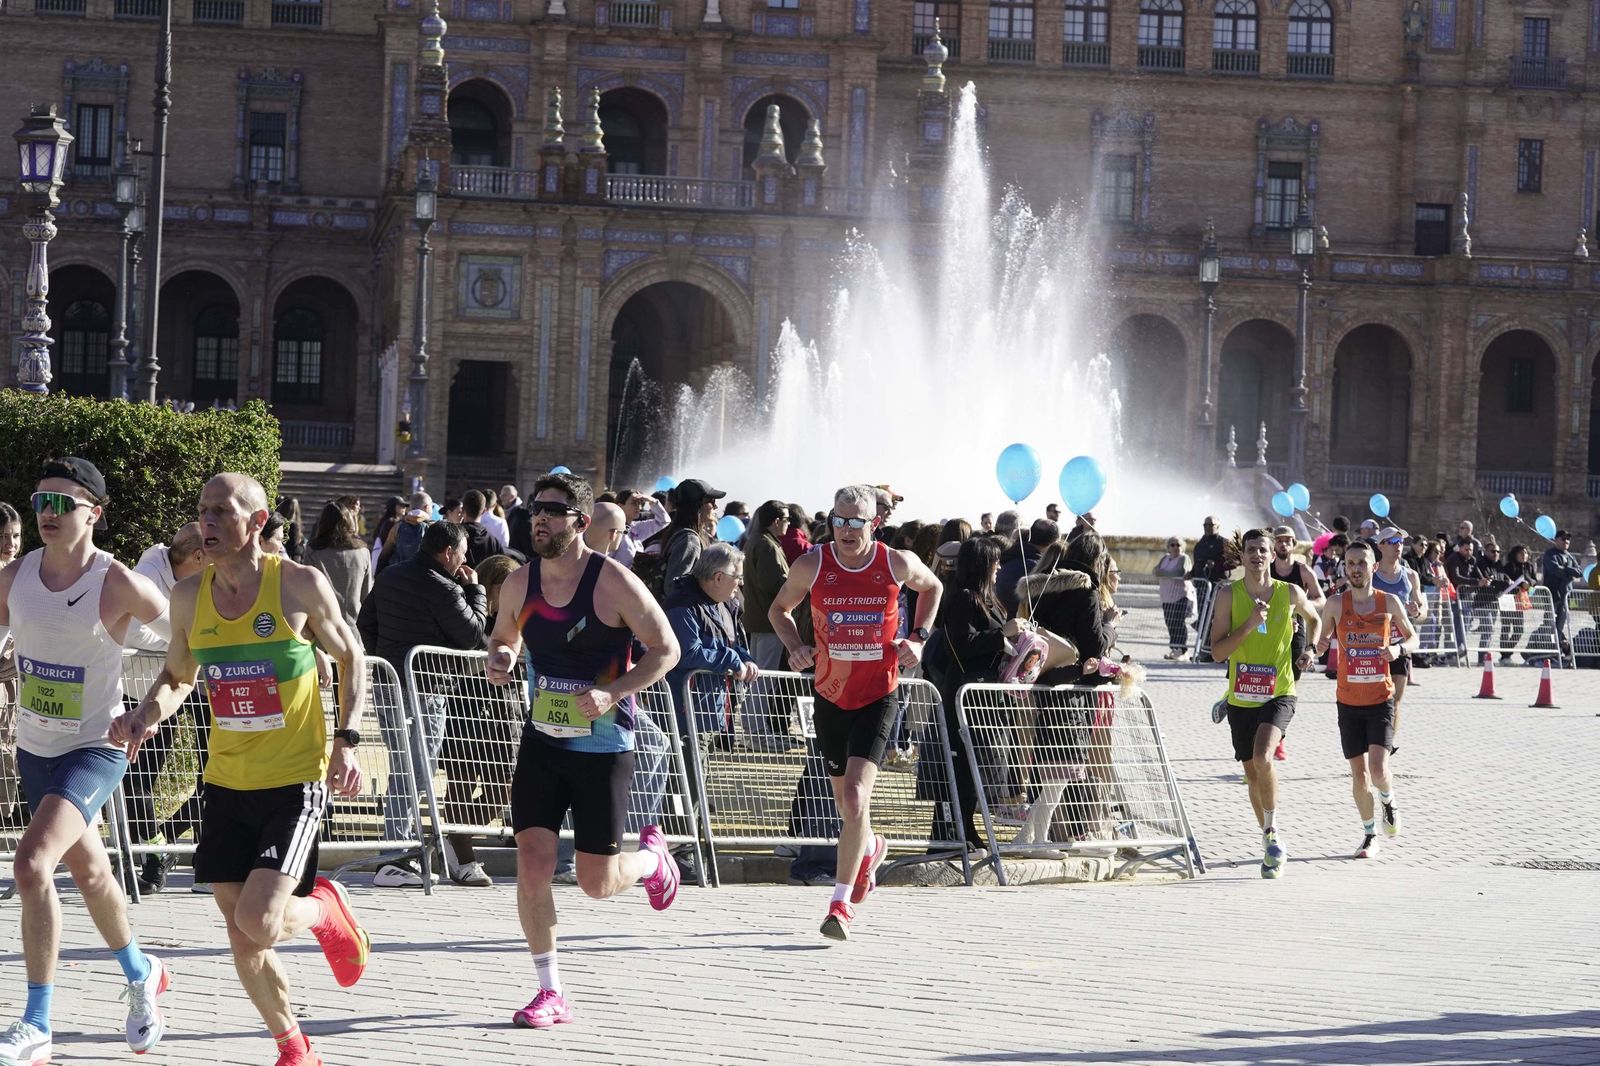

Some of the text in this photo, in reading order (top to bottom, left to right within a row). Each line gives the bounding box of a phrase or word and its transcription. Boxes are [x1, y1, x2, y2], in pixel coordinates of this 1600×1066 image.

[823, 597, 887, 605] SELBY STRIDERS
[828, 642, 883, 650] MARATHON MARK
[36, 665, 76, 679] ZURICH
[225, 665, 265, 677] ZURICH
[37, 686, 55, 698] 1922
[230, 687, 250, 697] 1427
[1239, 683, 1270, 694] VINCENT
[30, 695, 64, 716] ADAM
[231, 701, 256, 715] LEE
[550, 699, 569, 708] 1820
[547, 710, 570, 724] ASA
